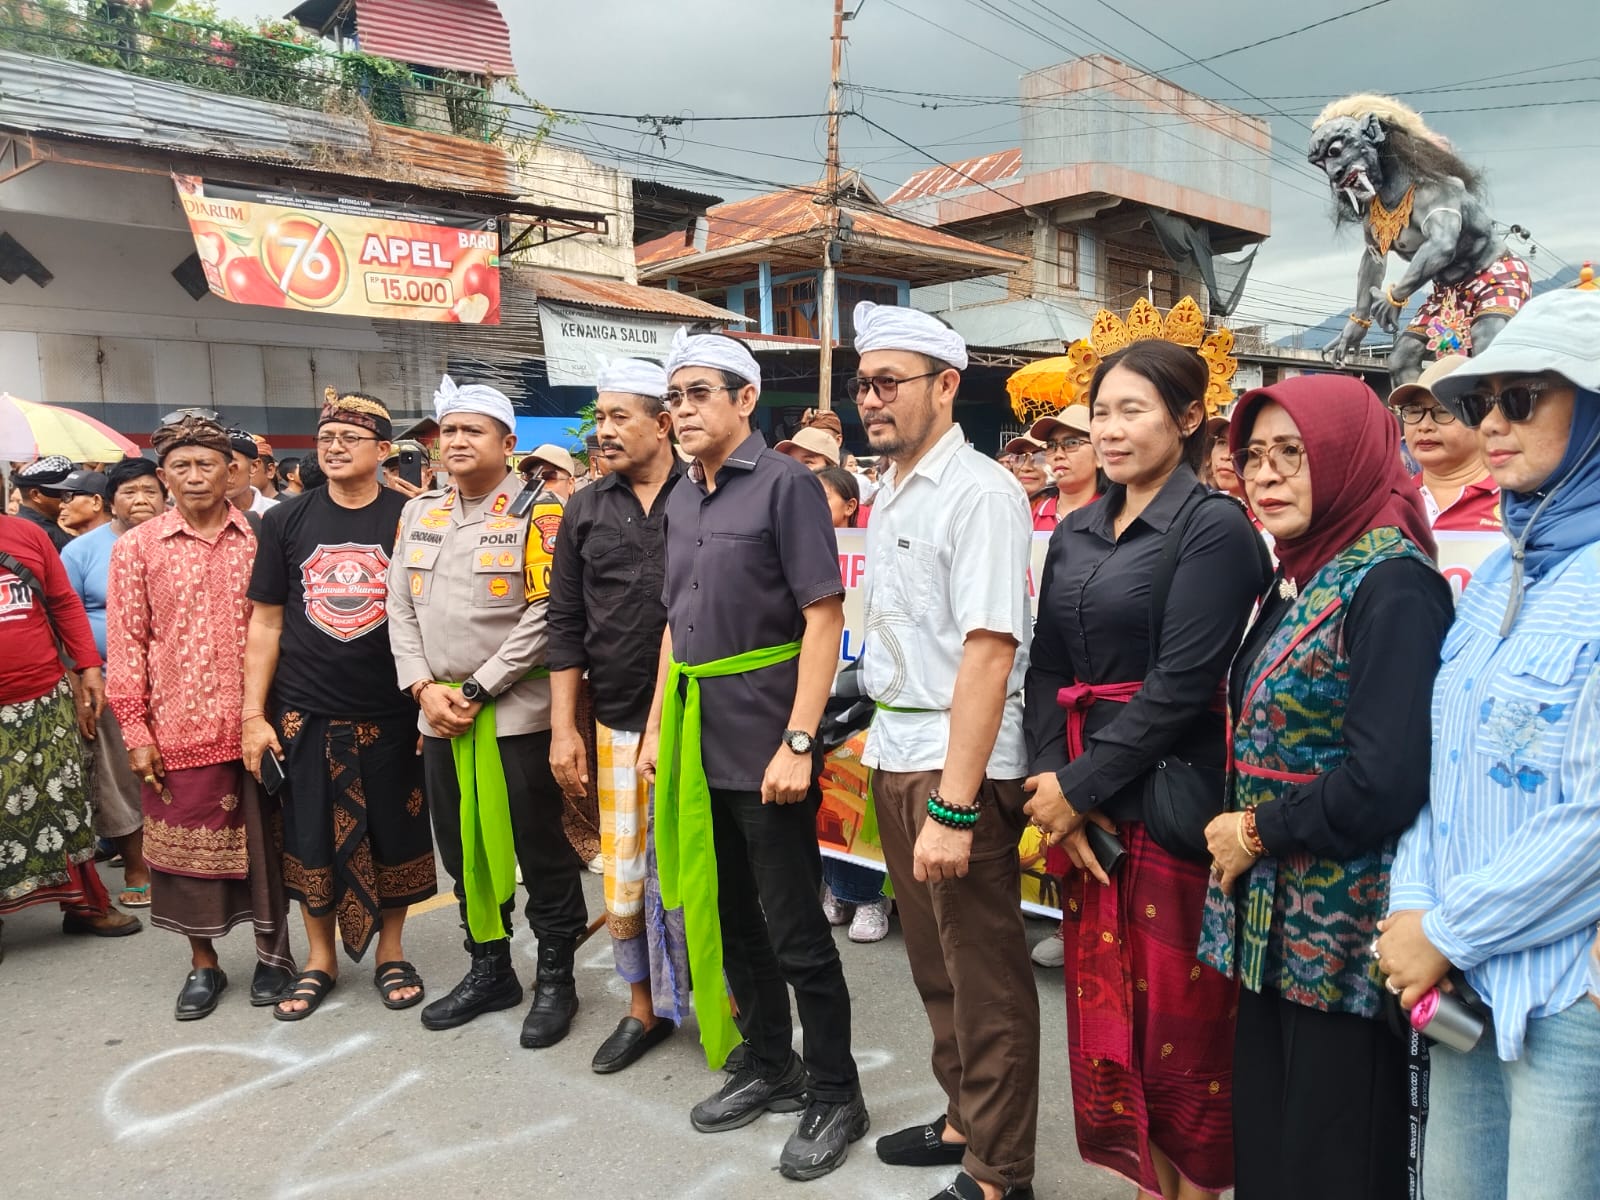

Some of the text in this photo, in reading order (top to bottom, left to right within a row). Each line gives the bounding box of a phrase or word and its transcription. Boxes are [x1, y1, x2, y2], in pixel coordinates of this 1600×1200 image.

[184, 199, 244, 221] DJARUM
[361, 235, 453, 270] APEL
[457, 231, 497, 251] BARU
[276, 222, 332, 295] 76
[380, 278, 448, 304] 15.000
[560, 322, 658, 345] KENANGA SALON
[479, 533, 518, 546] POLRI
